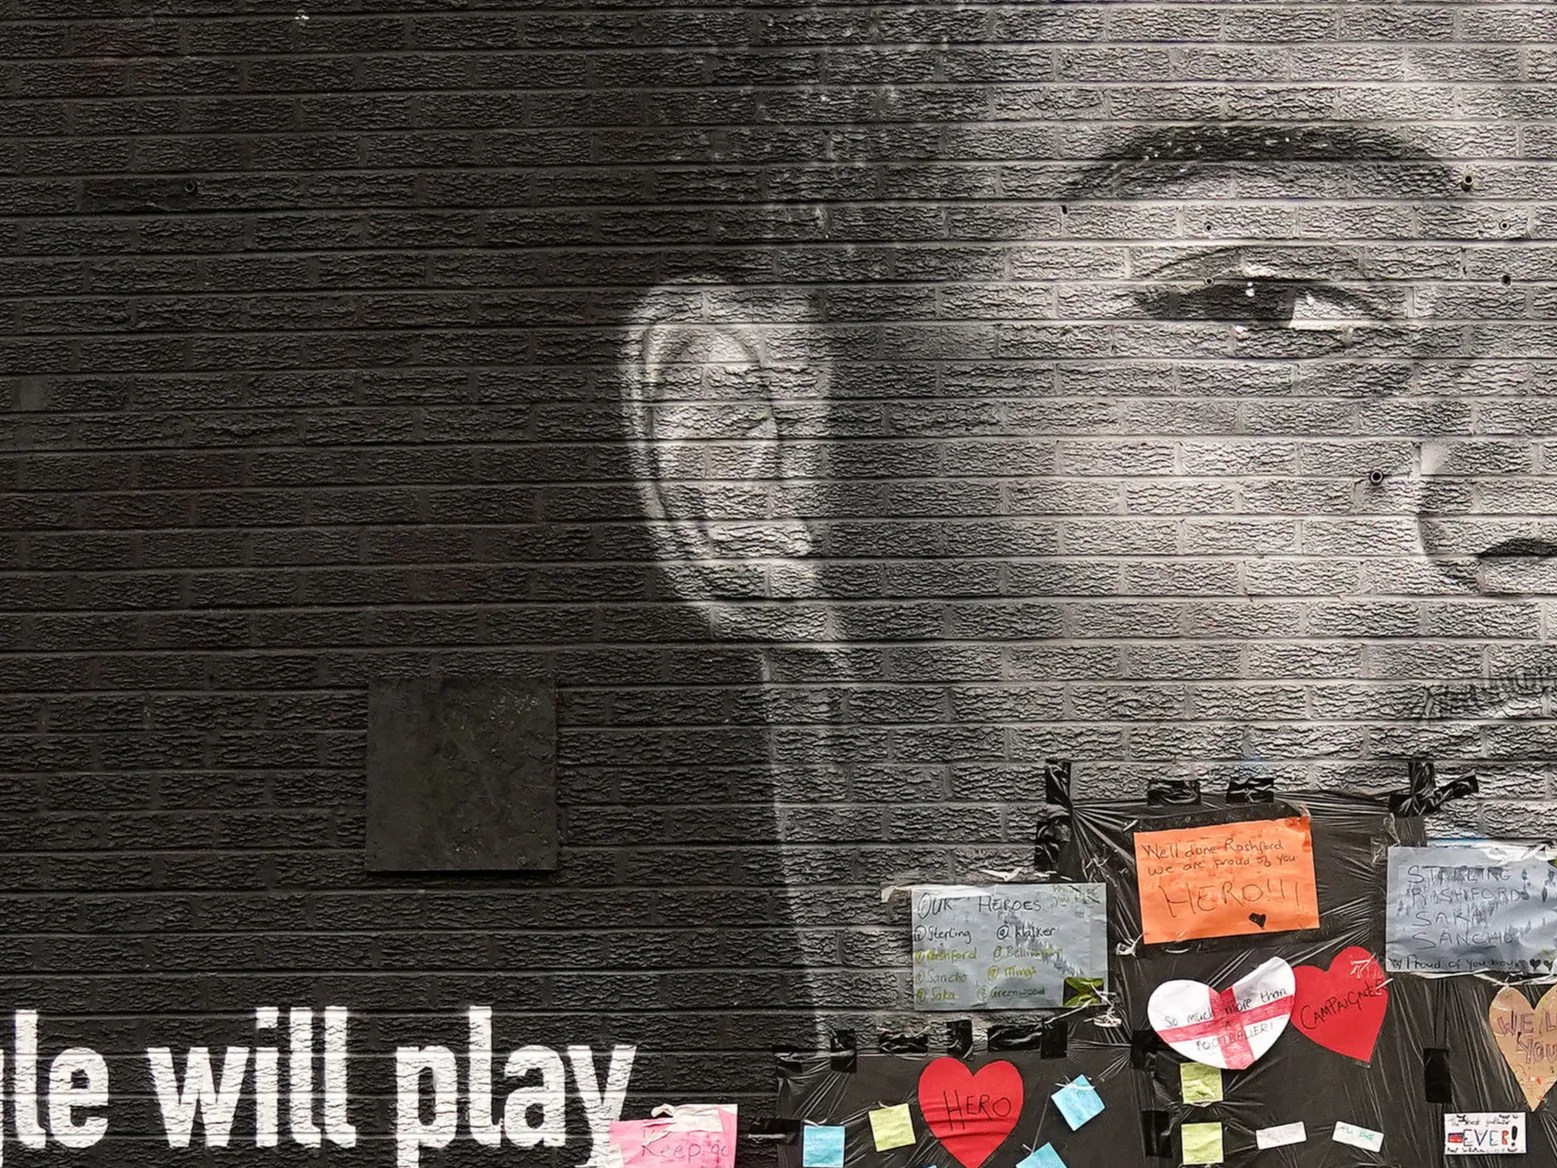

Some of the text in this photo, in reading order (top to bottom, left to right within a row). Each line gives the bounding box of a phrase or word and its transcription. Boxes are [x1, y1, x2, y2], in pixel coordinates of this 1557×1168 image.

[1140, 842, 1179, 860] Well
[1185, 843, 1217, 858] done
[1147, 865, 1175, 876] we
[1182, 861, 1205, 871] are
[1214, 856, 1250, 869] proud
[1277, 853, 1296, 863] you
[918, 892, 1042, 919] OUR HEROES
[1407, 955, 1440, 969] Proud
[1467, 960, 1485, 971] you
[1164, 1014, 1179, 1028] So
[1225, 997, 1253, 1014] more
[1260, 987, 1287, 1002] than
[1496, 1010, 1534, 1035] WE
[1518, 1039, 1557, 1064] YOU
[147, 1006, 357, 1148] will
[943, 1090, 1011, 1131] HERO
